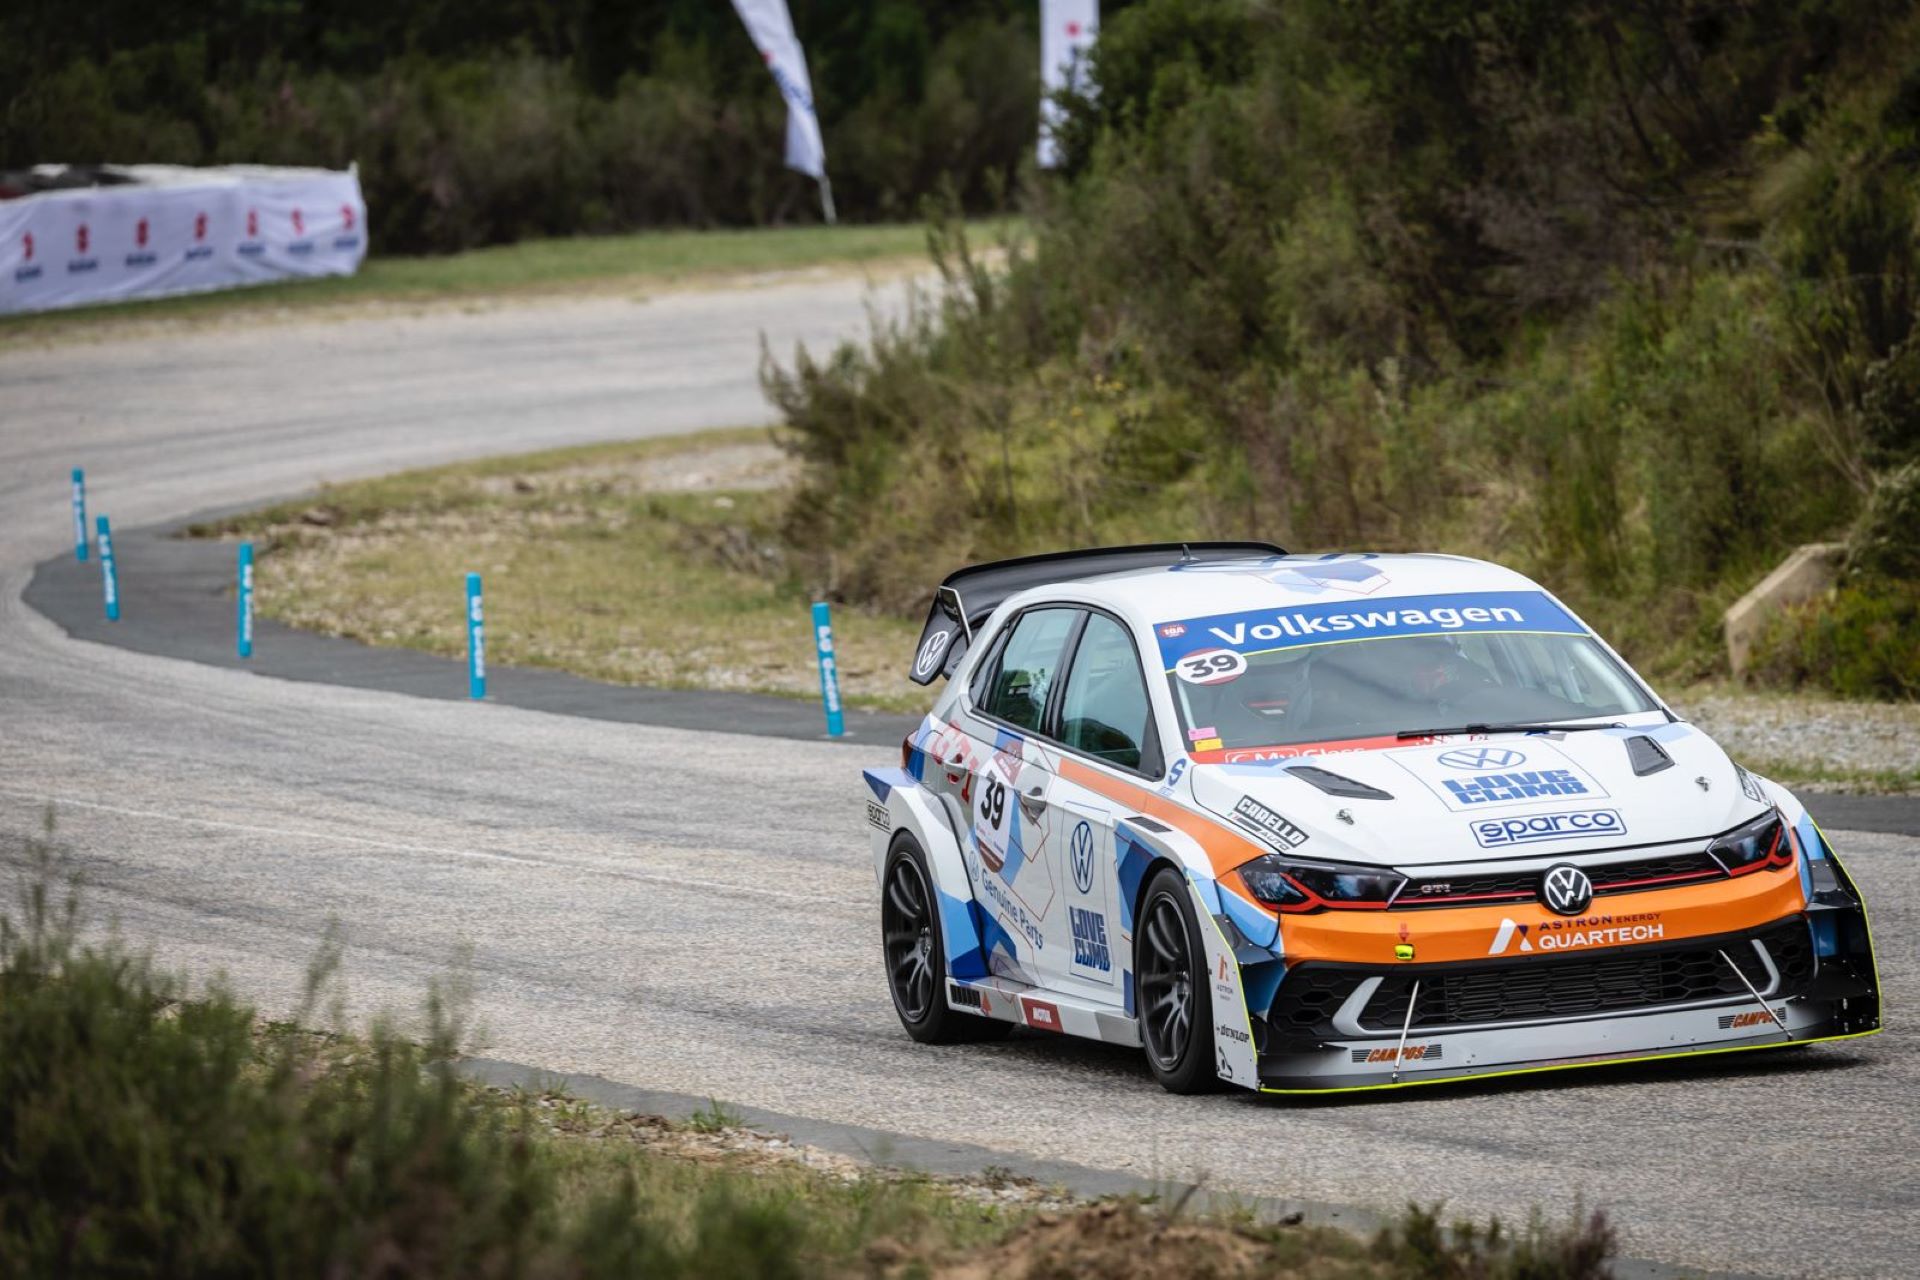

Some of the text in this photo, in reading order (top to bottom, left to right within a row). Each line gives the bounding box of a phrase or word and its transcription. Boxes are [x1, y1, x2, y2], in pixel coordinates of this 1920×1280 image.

[1209, 606, 1524, 645] Volkswagen
[1183, 654, 1239, 679] 39
[1441, 769, 1579, 793] LOVE
[1454, 781, 1589, 804] CLIMB
[980, 769, 1004, 831] 39
[1237, 797, 1306, 845] CARELLO
[1479, 812, 1616, 842] sparco
[1258, 830, 1290, 851] AUTO
[1420, 883, 1451, 894] GTI
[981, 867, 1019, 923] Genuine
[1019, 906, 1044, 950] Parts
[1538, 912, 1662, 931] ASTRON ENERGY
[1069, 905, 1108, 946] LOVE
[1538, 923, 1664, 950] QUARTECH
[1074, 936, 1112, 972] CLIMB
[1220, 1023, 1250, 1043] DUNLOP
